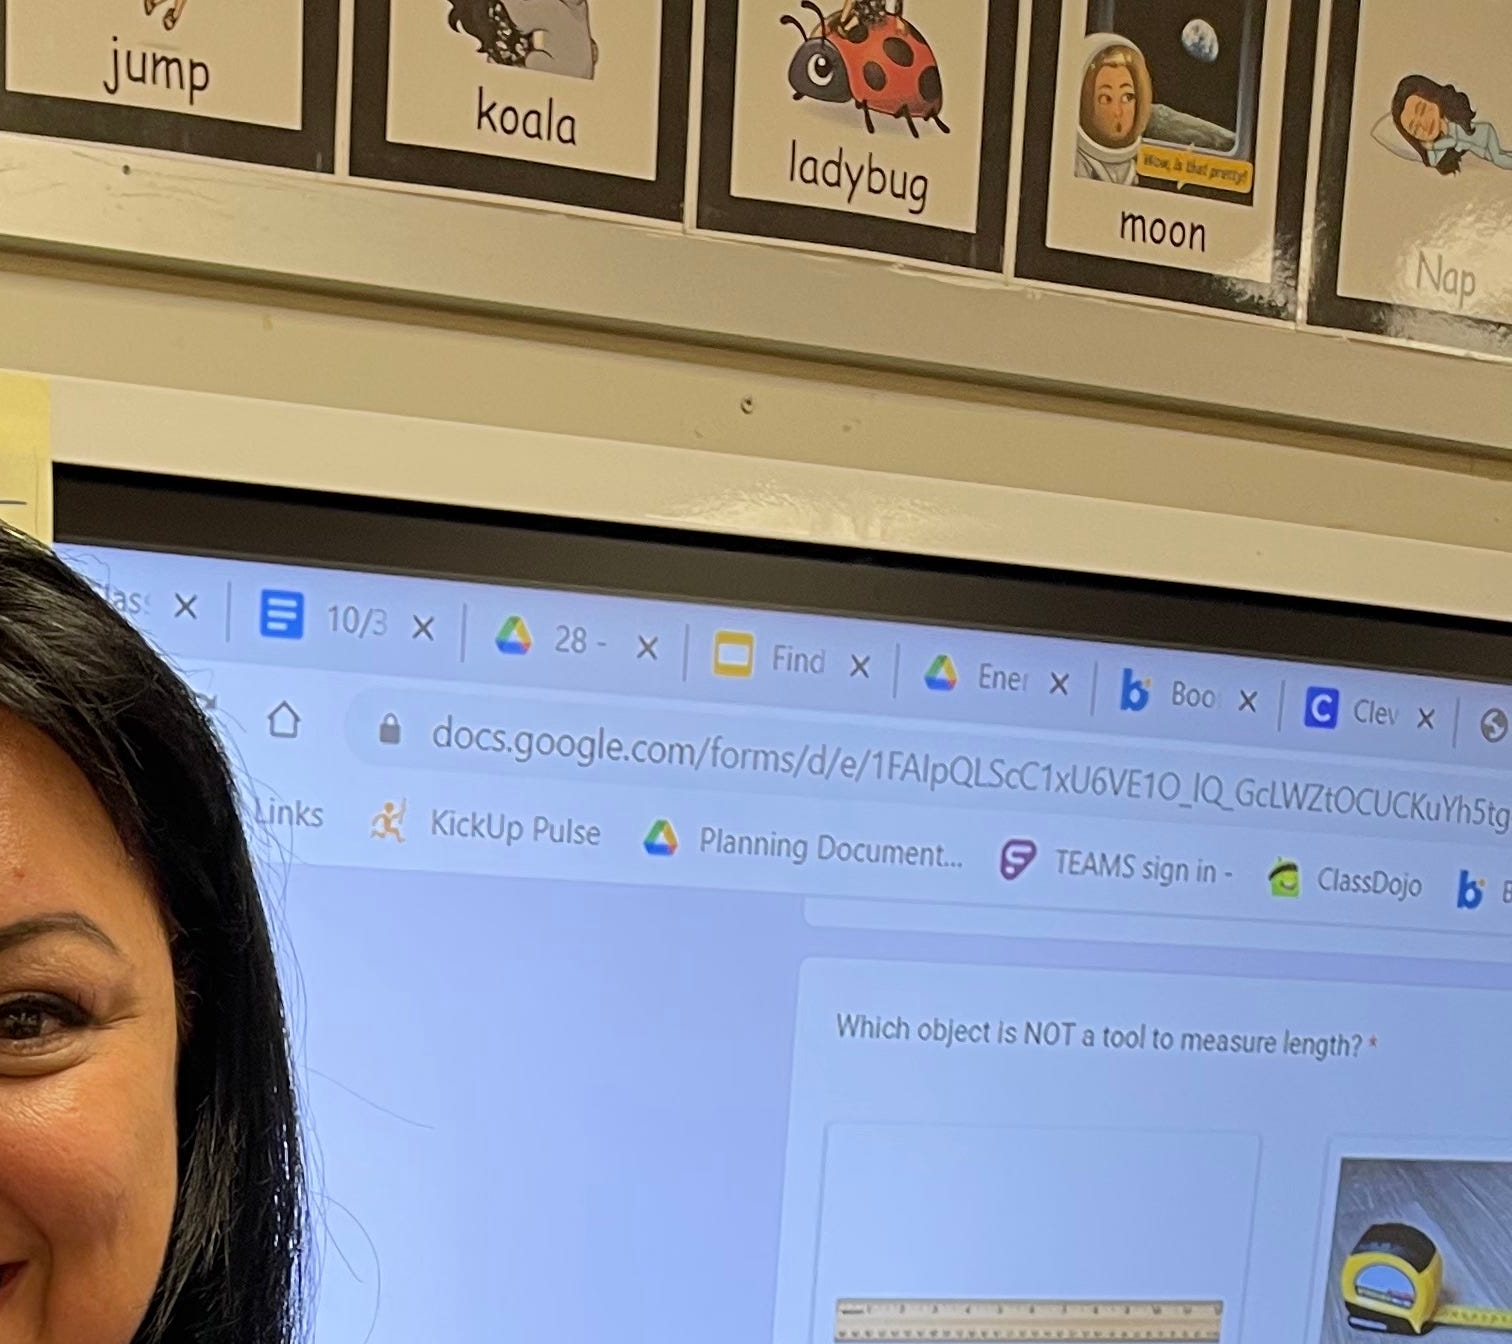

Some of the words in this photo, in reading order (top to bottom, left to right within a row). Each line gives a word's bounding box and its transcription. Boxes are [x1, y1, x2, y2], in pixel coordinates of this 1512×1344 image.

[102, 36, 212, 104] jump
[475, 85, 579, 147] koala
[787, 139, 928, 214] ladybug
[1118, 207, 1206, 253] moon
[1414, 250, 1477, 309] Nap
[327, 603, 388, 639] 10/3
[554, 624, 588, 654] 28
[772, 643, 826, 676] Find
[254, 797, 324, 829] Links
[429, 808, 524, 847] KickUp
[533, 815, 602, 846] Pulse
[699, 825, 809, 866] Planning
[1055, 848, 1136, 879] TEAMS
[1142, 855, 1190, 888] sign
[1197, 857, 1217, 884] in
[1317, 867, 1424, 903] ClassDojo
[835, 1013, 911, 1041] Which
[917, 1017, 991, 1048] object
[996, 1021, 1018, 1044] is
[1022, 1021, 1077, 1047] NOT
[1080, 1028, 1096, 1048] a
[1101, 1023, 1147, 1051] tool
[1151, 1027, 1175, 1052] to
[1179, 1031, 1277, 1055] measure
[1282, 1029, 1364, 1062] length?
